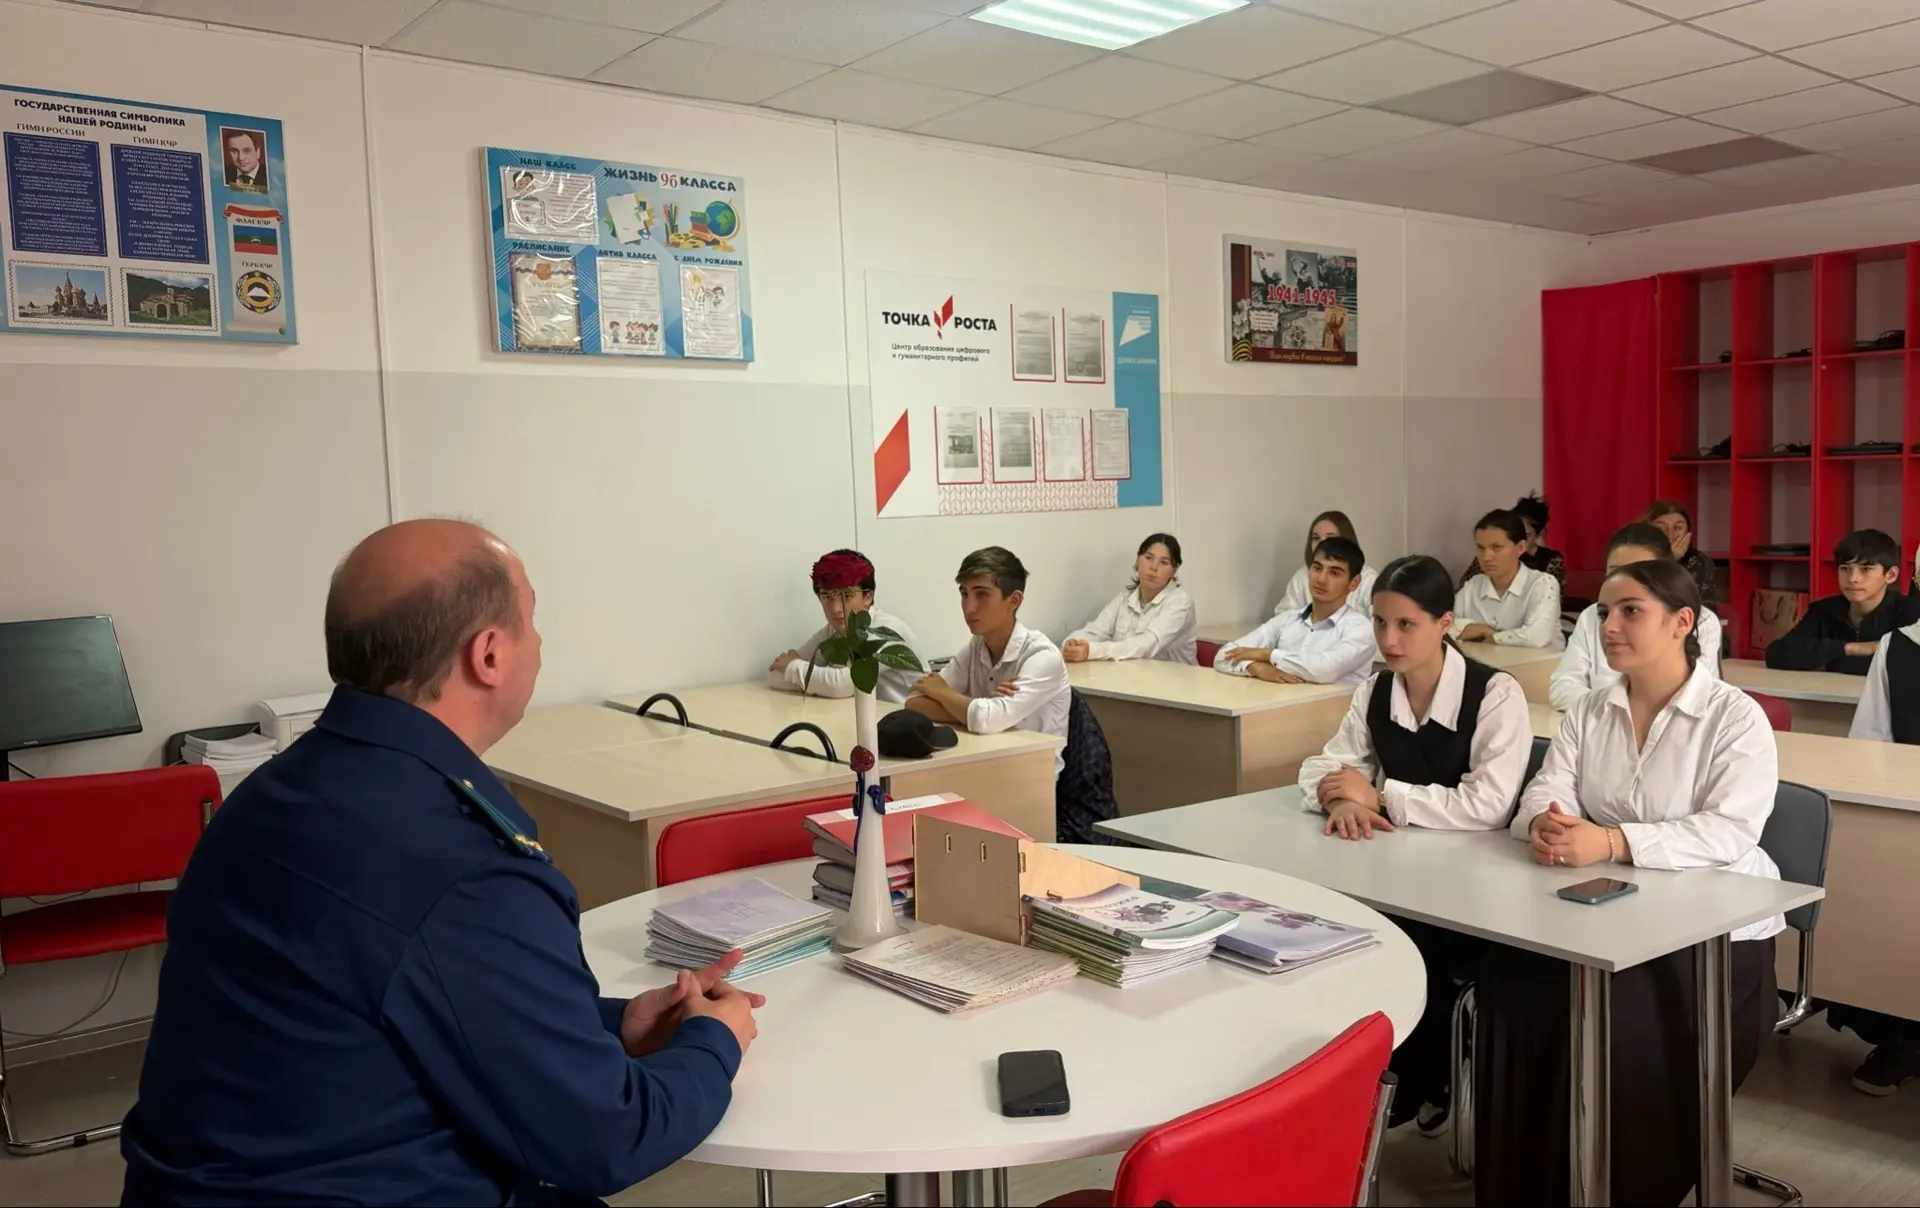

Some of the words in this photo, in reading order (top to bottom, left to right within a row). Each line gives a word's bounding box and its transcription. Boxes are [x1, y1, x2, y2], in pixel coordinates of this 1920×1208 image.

[14, 99, 117, 118] ГОСУДАРСТВЕННАЯ
[120, 111, 186, 127] СИМВОЛИКА
[58, 115, 97, 127] НАШЕЙ
[100, 120, 147, 132] РОДИНЫ
[16, 124, 45, 133] ГИМН
[46, 127, 85, 137] РОССИИ
[133, 136, 159, 145] ГИМН
[520, 157, 542, 166] НАШ
[546, 161, 576, 170] КЛАСС
[604, 167, 657, 183] ЖИЗНЬ
[680, 176, 737, 192] КЛАССА
[512, 242, 570, 253] РАСПИСАНИЕ
[598, 249, 624, 258] АКТИВ
[627, 251, 657, 260] КЛАССА
[704, 258, 743, 266] РОЖДЕНИЯ
[1267, 284, 1336, 305] 1941-1945
[882, 311, 931, 327] ТОЧКА
[954, 316, 997, 331] РОСТА
[891, 343, 912, 352] Центр
[913, 344, 955, 353] образования
[898, 353, 946, 361] гуманитарного
